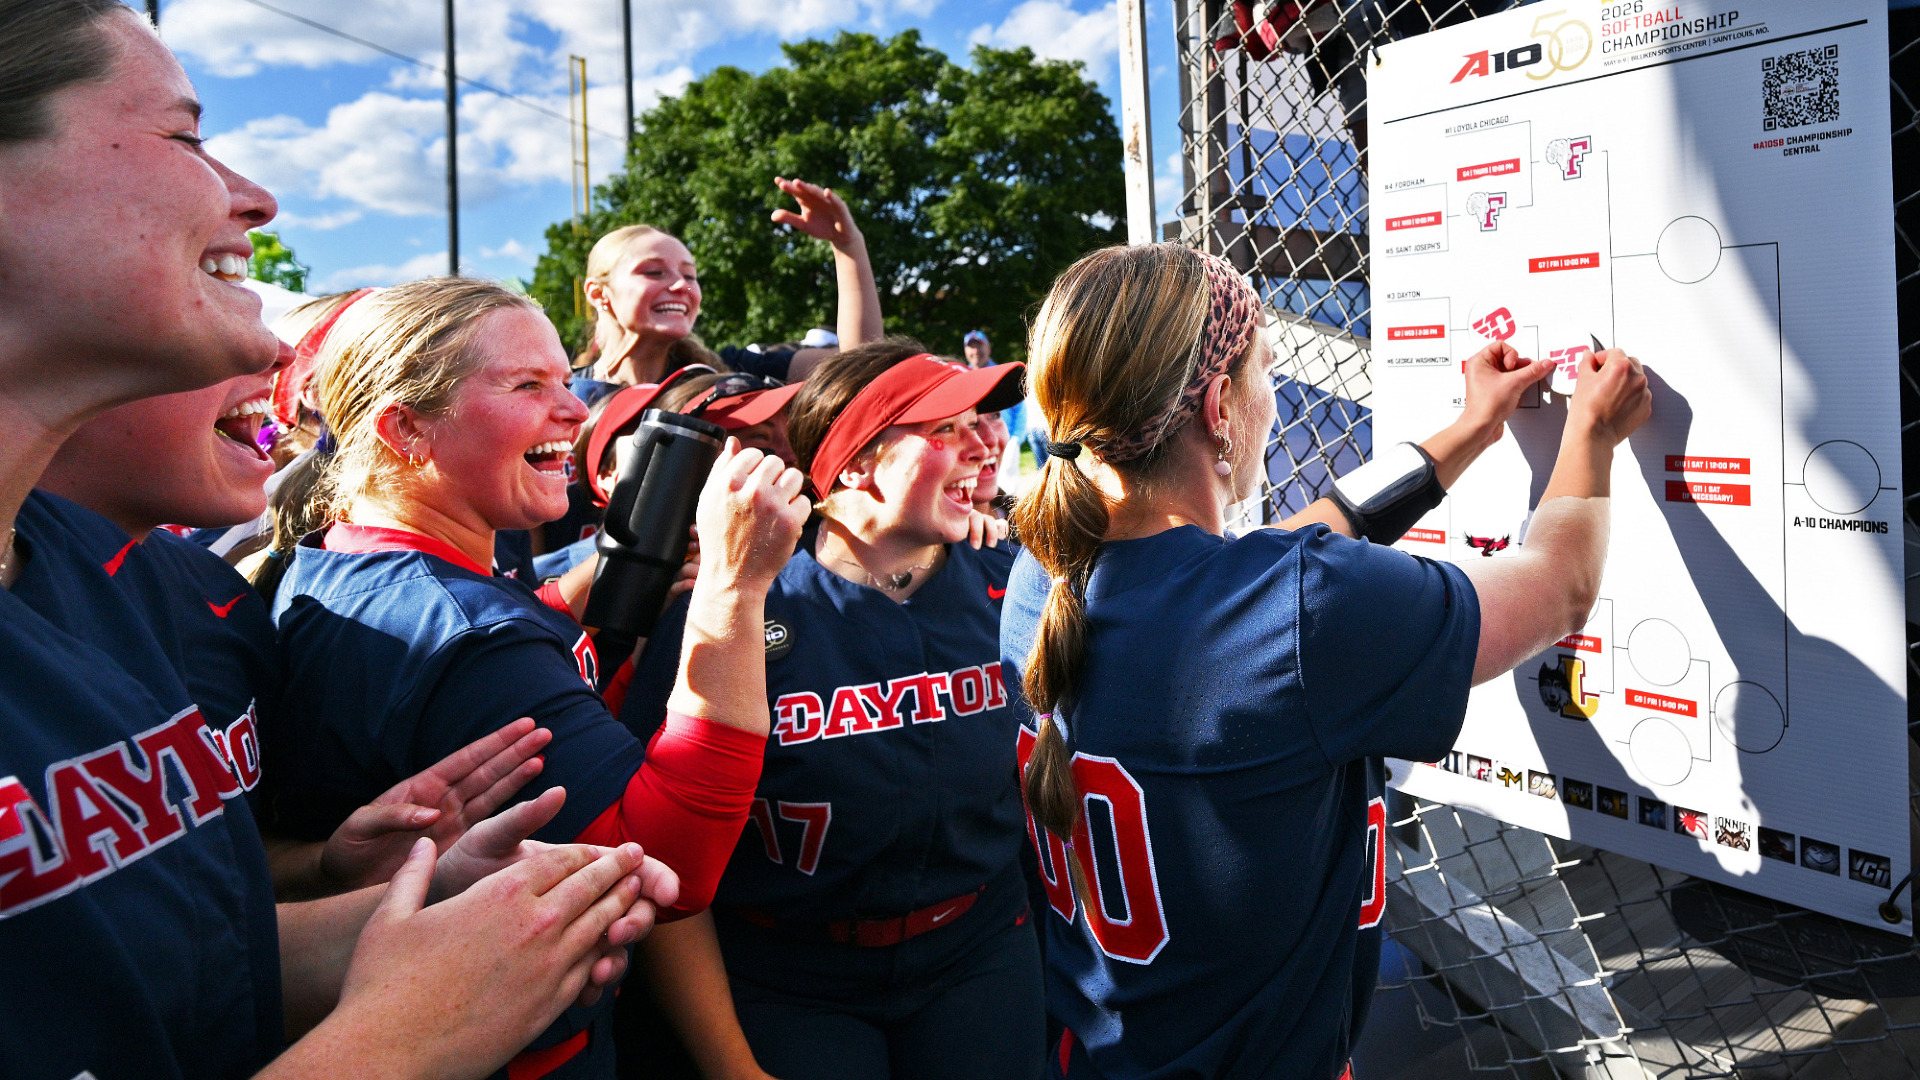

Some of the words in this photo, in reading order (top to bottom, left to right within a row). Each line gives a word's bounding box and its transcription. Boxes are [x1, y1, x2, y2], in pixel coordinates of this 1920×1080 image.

[1601, 0, 1644, 21] 2026
[1601, 6, 1684, 38] SOFTBALL
[1602, 10, 1740, 54] CHAMPIONSHIP
[1630, 51, 1657, 62] BILLIKEN
[1657, 45, 1682, 56] SPORTS
[1682, 40, 1707, 51] CENTER
[1712, 35, 1732, 45] SAINT
[1732, 29, 1755, 41] LOUIS,
[1755, 26, 1770, 36] MO.
[1449, 43, 1542, 84] A10
[1453, 122, 1478, 134] LOYOLA
[1479, 115, 1510, 129] CHICAGO
[1753, 138, 1785, 150] #A10SB
[1786, 128, 1853, 145] CHAMPIONSHIP
[1783, 144, 1821, 157] CENTRAL
[1395, 178, 1425, 189] FORDHAM
[1395, 245, 1412, 254] SAINT
[1414, 242, 1441, 252] JOSEPH'S
[1579, 257, 1590, 265] PM
[1397, 291, 1421, 299] DAYTON
[1452, 397, 1462, 405] #2
[1690, 461, 1704, 469] SAT
[1709, 462, 1727, 470] 12:00
[1729, 463, 1741, 471] PM
[1708, 486, 1721, 494] SAT
[1691, 493, 1734, 503] NECESSARY)
[1793, 516, 1816, 529] A-10
[1819, 517, 1889, 535] CHAMPIONS
[1584, 639, 1594, 648] PM
[1677, 703, 1689, 712] PM
[748, 797, 832, 877] 17
